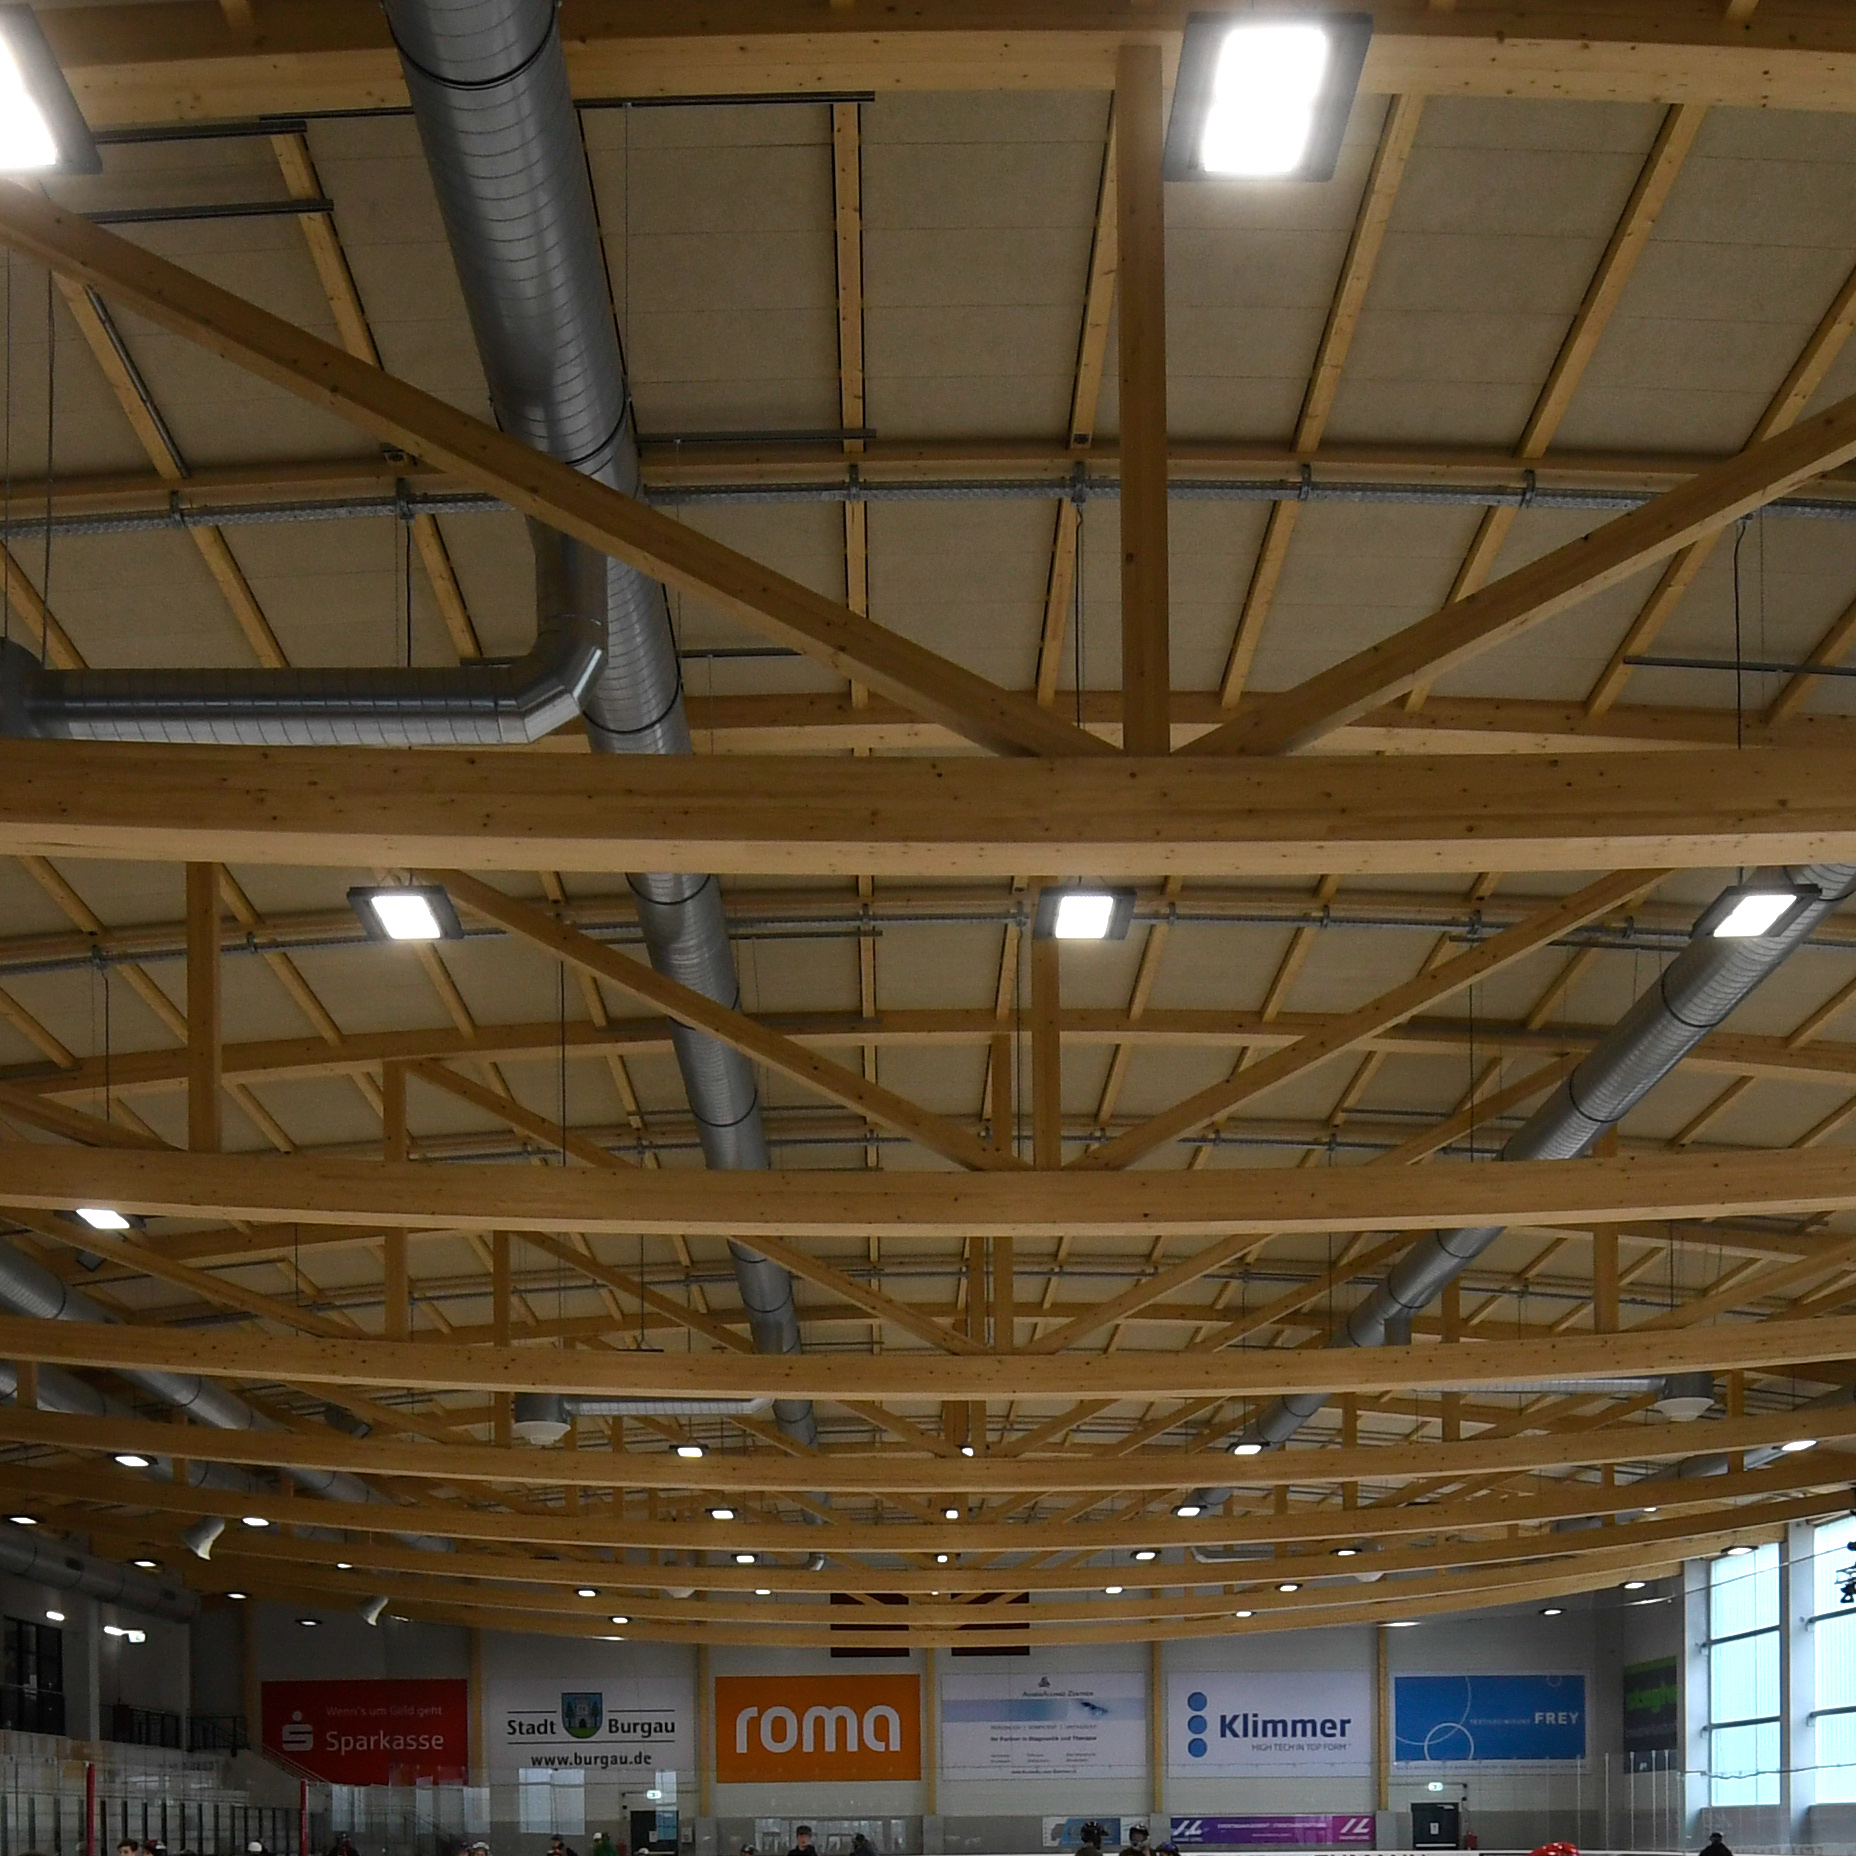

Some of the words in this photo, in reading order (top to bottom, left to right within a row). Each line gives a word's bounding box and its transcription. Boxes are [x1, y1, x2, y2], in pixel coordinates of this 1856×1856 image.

[369, 1708, 388, 1716] um
[416, 1706, 443, 1718] geht
[1534, 1711, 1579, 1725] FREY
[507, 1719, 556, 1735] Stadt
[608, 1718, 676, 1738] Burgau
[736, 1704, 901, 1754] roma
[1220, 1713, 1352, 1739] Klimmer
[326, 1730, 445, 1756] Sparkasse
[531, 1751, 652, 1770] www.burgau.de
